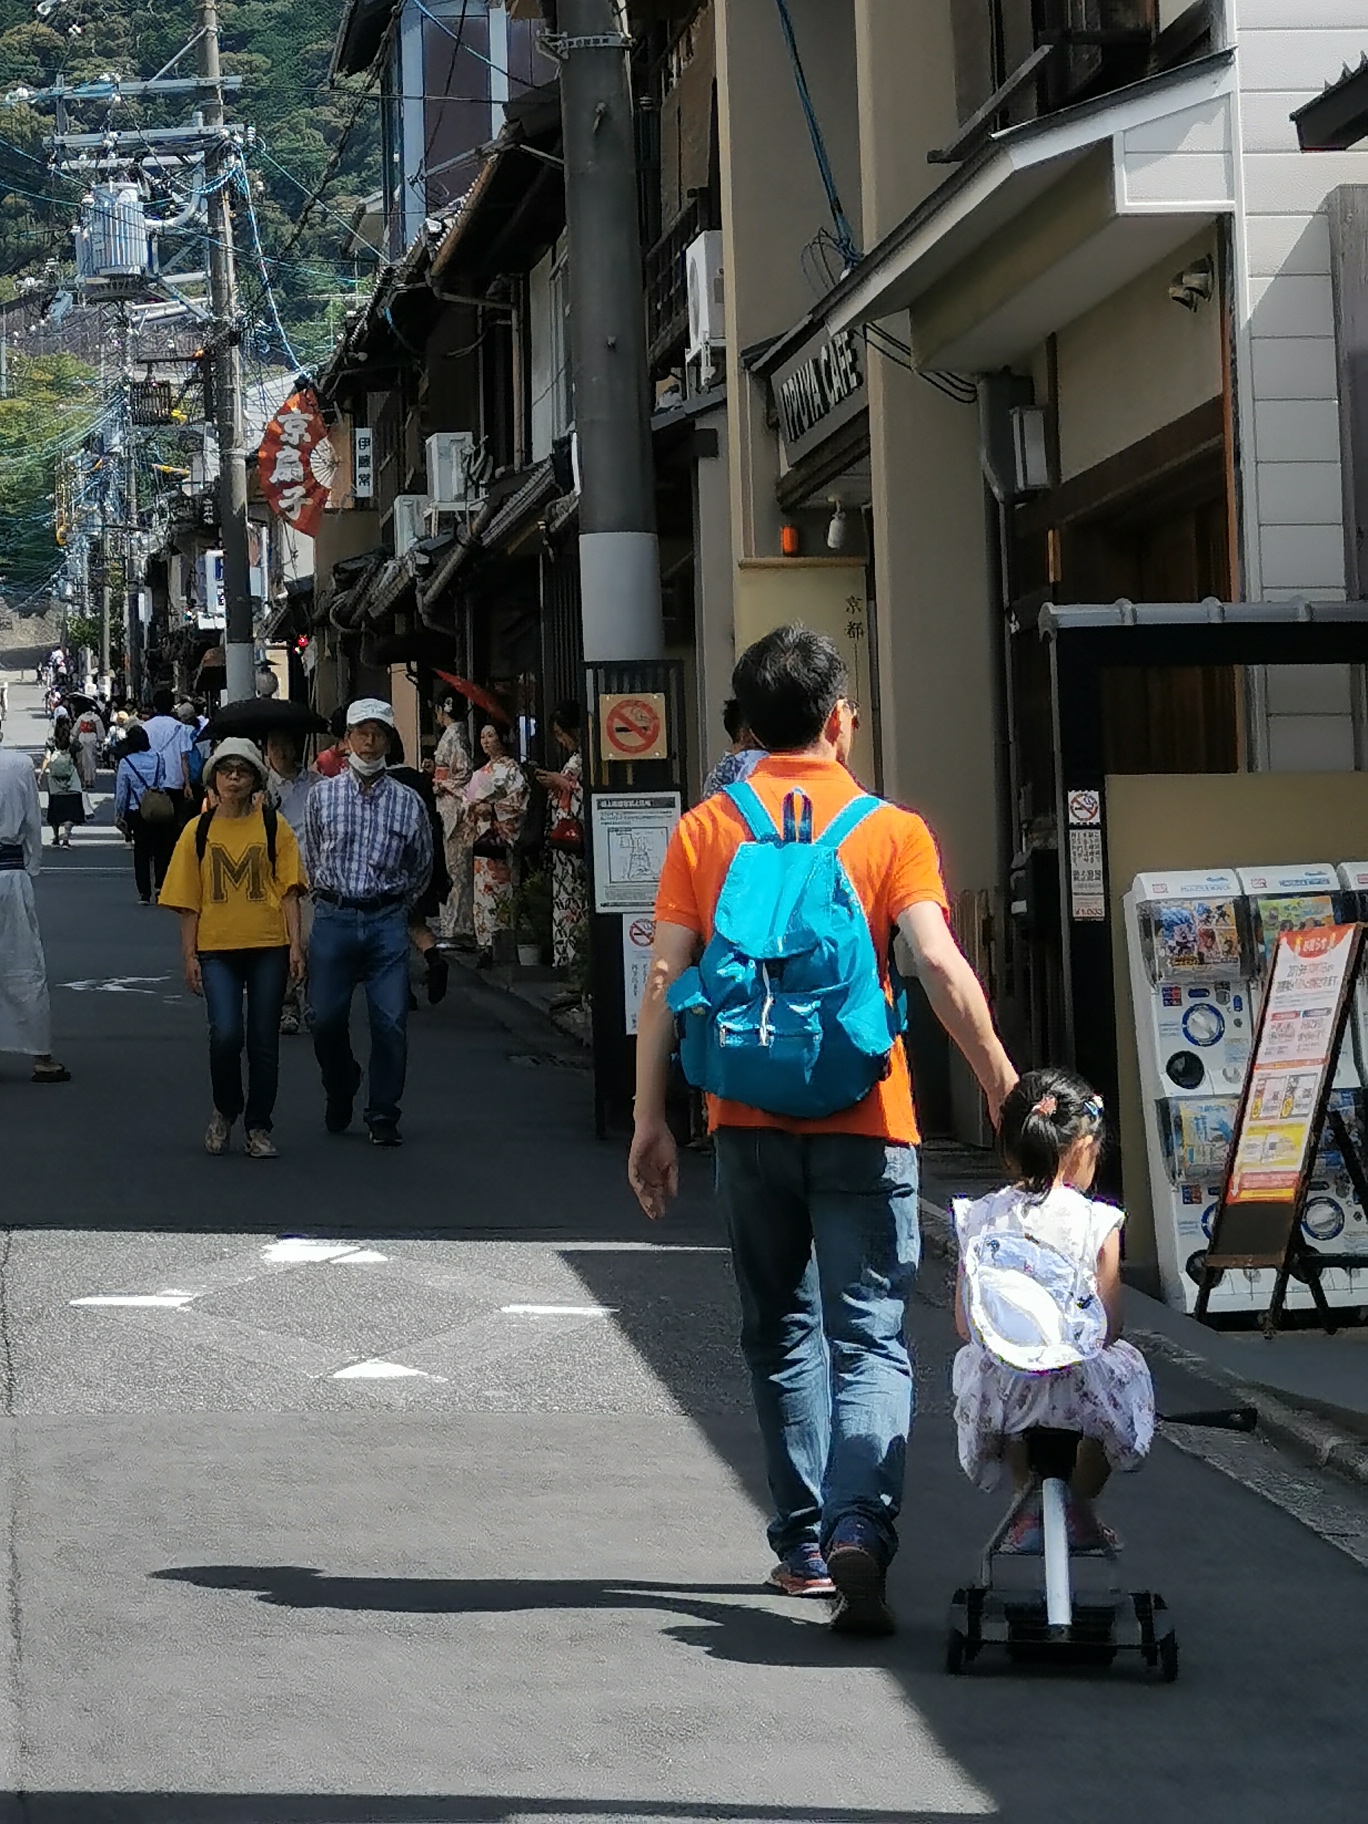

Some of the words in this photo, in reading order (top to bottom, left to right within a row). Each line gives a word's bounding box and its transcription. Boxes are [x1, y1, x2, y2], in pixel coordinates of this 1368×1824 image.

[821, 330, 861, 406] CAFE
[269, 409, 314, 520] 京扇子
[844, 594, 865, 642] 京都
[210, 843, 266, 903] M
